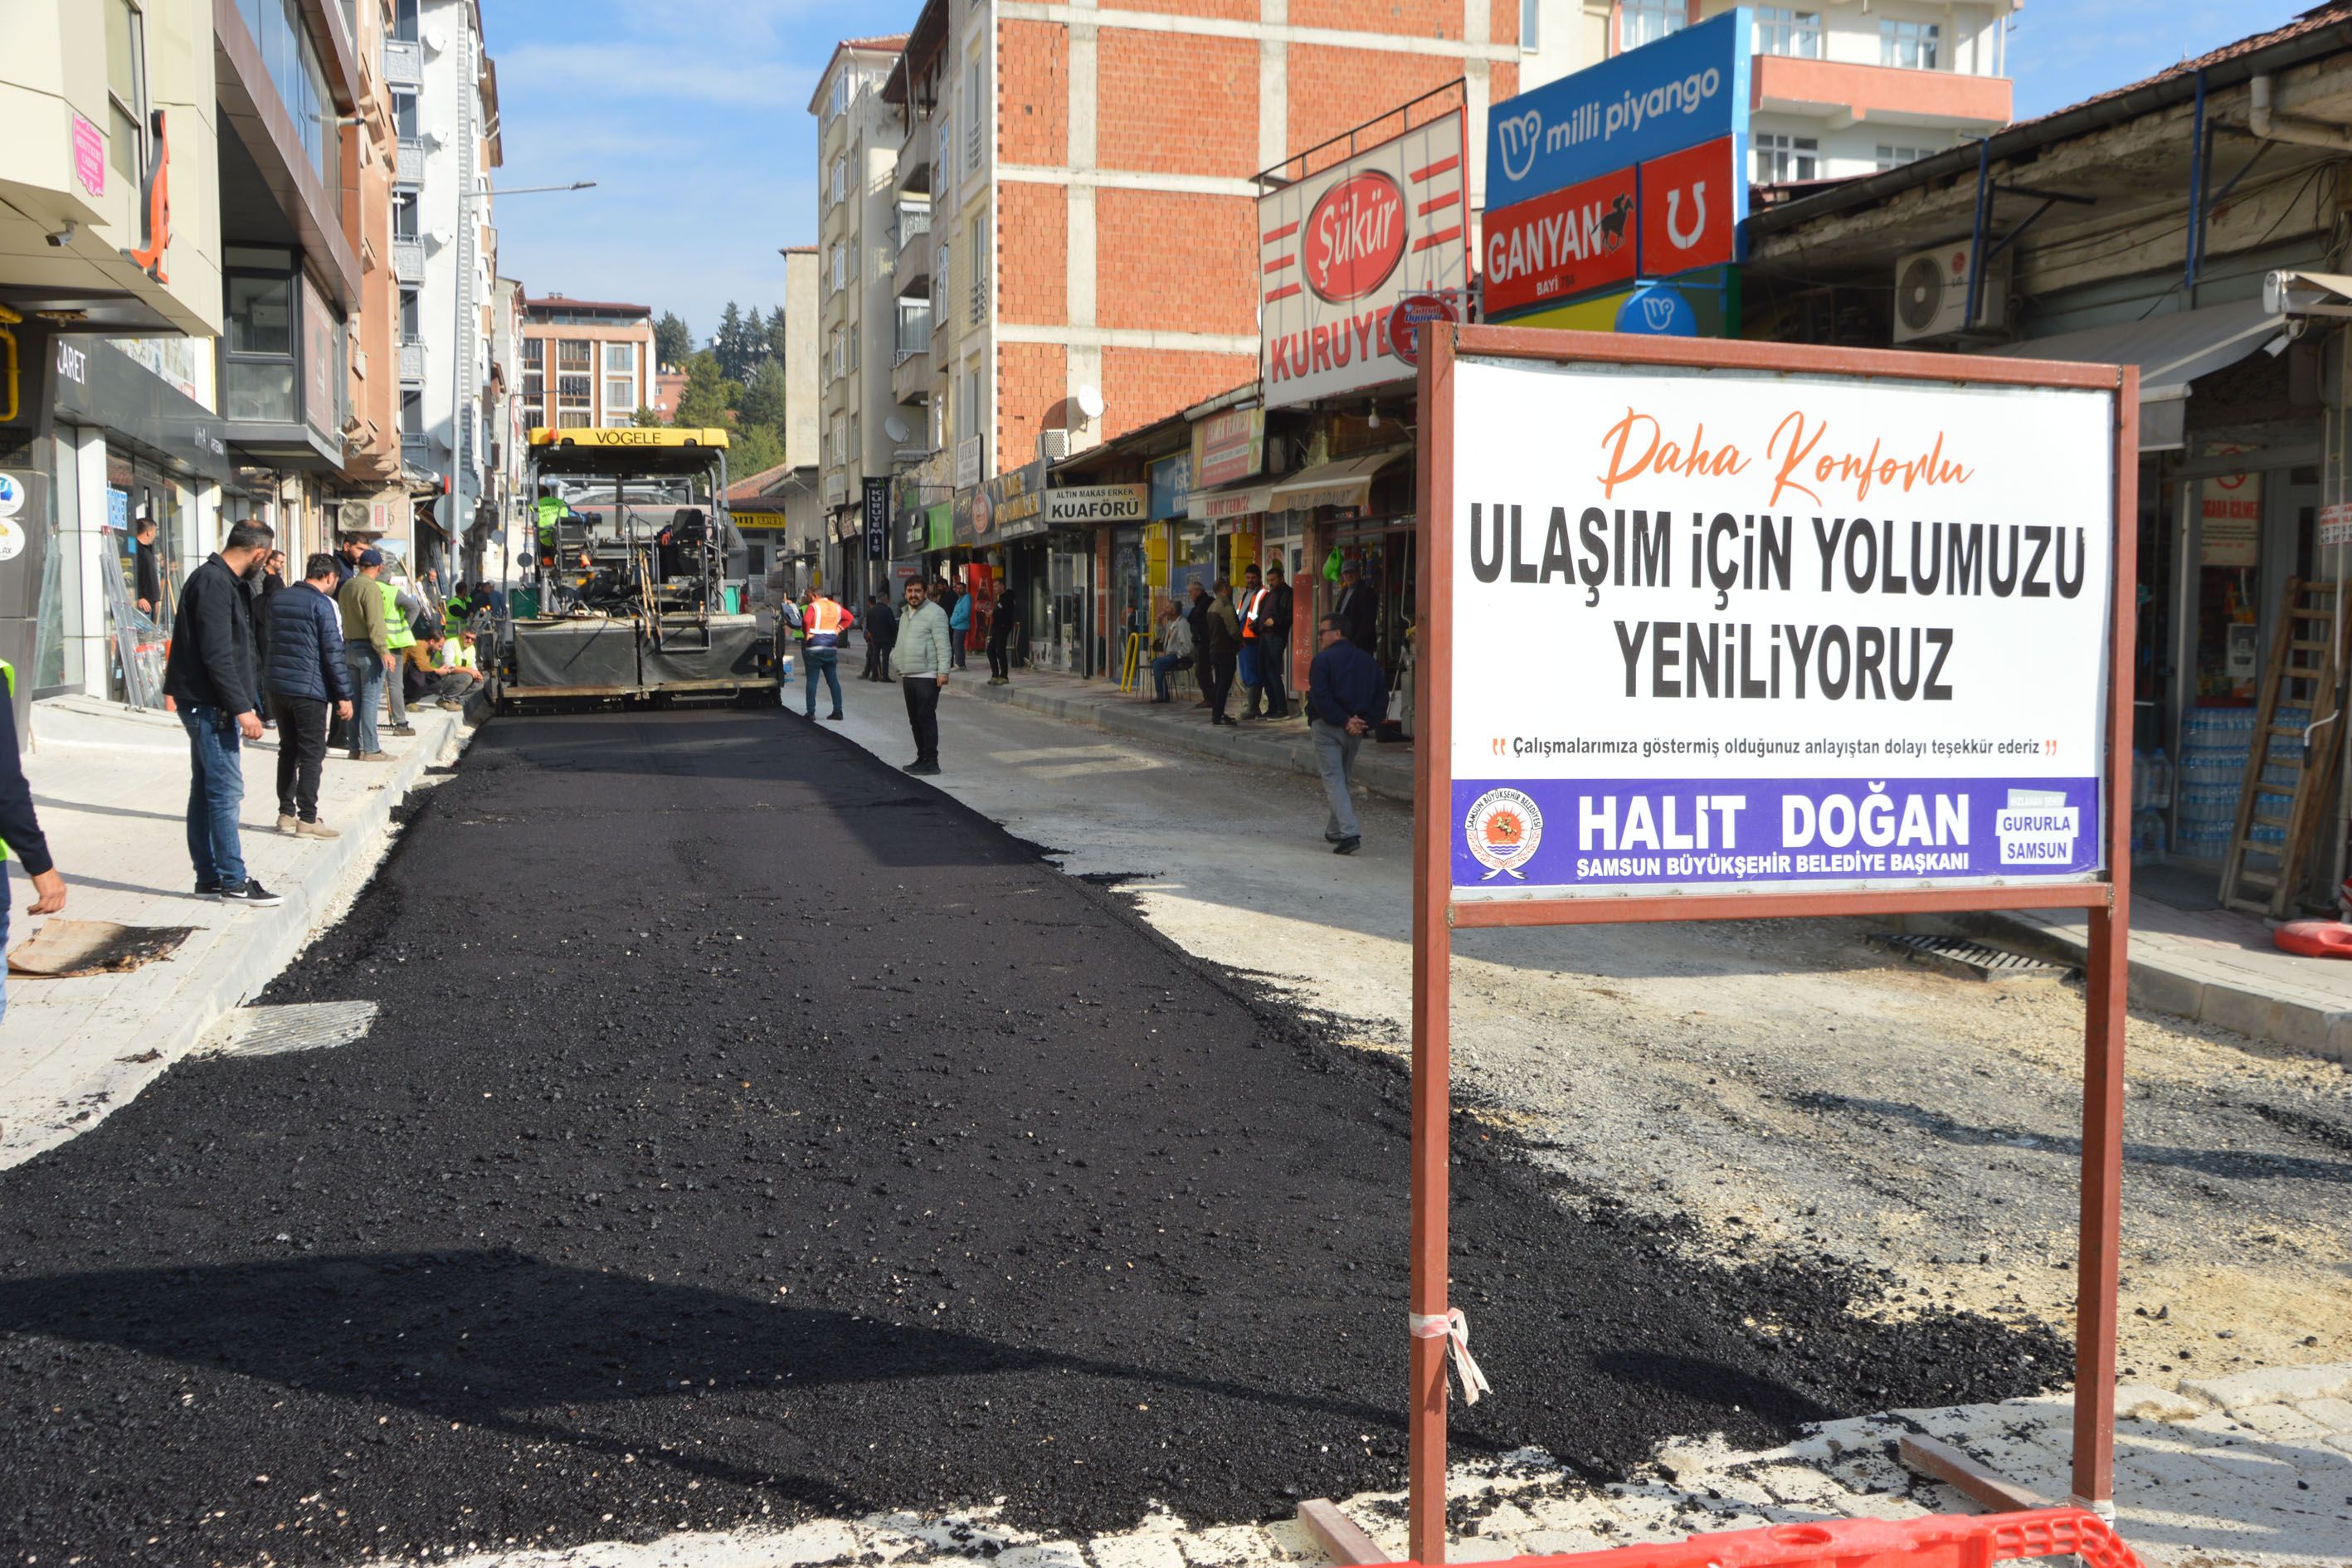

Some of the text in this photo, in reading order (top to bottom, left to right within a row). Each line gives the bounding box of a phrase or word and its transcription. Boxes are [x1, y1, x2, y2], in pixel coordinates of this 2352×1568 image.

[1546, 67, 1719, 153] milli piyango
[1318, 188, 1397, 289] Şükür
[1488, 201, 1602, 285] GANYAN
[1536, 275, 1559, 296] BAYİ
[596, 430, 662, 445] VÖGELE
[1598, 407, 1973, 508] Daha Konforlu
[1052, 498, 1139, 519] KUAFÖRÜ
[1079, 489, 1106, 498] MAKAS
[1108, 488, 1134, 496] ERKEK
[1470, 503, 2085, 611] ULAŞIM İÇİN YOLUMUZU
[1614, 621, 1954, 701] YENİLİYORUZ
[1513, 737, 2039, 758] Çalışmalarımıza göstermiş olduğunuz anlayıştan dolayı teşekkür ederiz
[1466, 789, 1542, 829] SAMSUN BÜYÜKŞEHİR BELEDİYESİ
[1579, 781, 1970, 851] HALİT DOĞAN
[2003, 816, 2071, 831] GURURLA
[1576, 850, 1970, 879] SAMSUN BÜYÜKŞEHİR BELEDİYE BAŞKANI
[2007, 842, 2067, 859] SAMSUN
